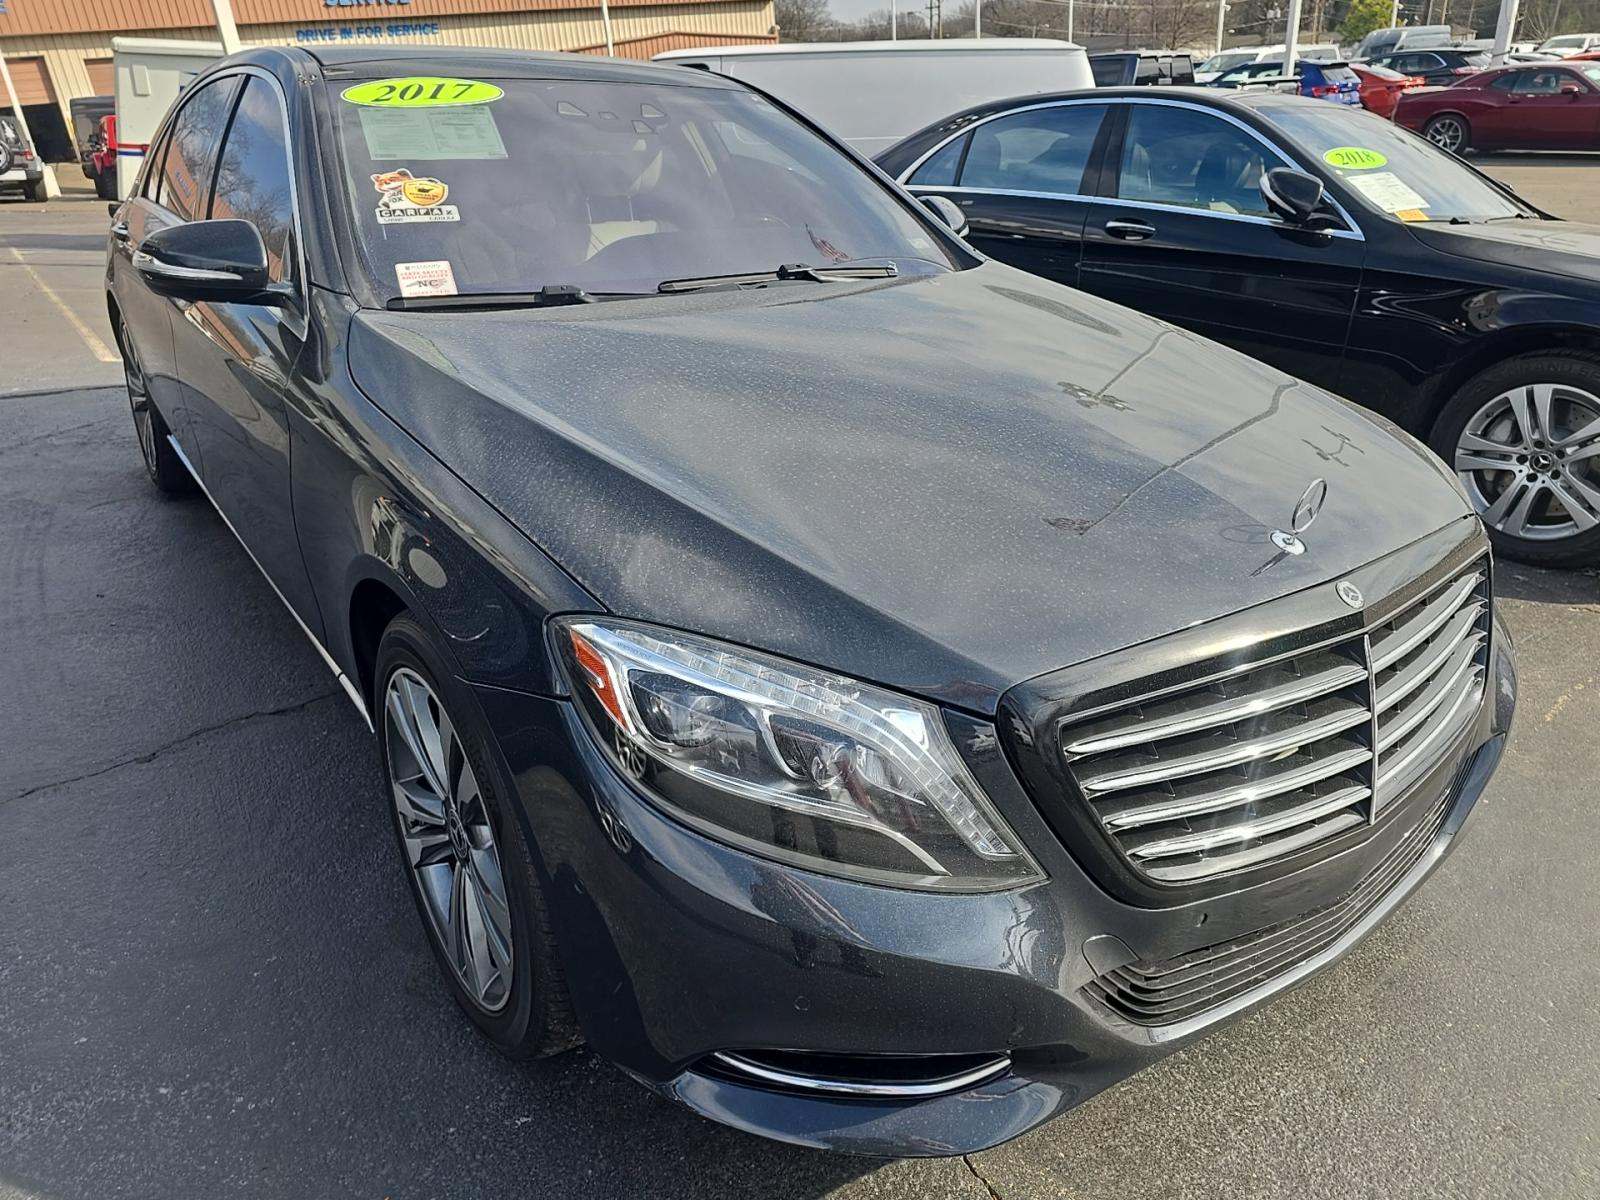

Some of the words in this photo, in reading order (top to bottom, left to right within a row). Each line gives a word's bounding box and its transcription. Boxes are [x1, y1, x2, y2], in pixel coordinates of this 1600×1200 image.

[296, 29, 336, 42] DRIVE
[339, 26, 353, 39] IN
[356, 25, 383, 39] FOR
[387, 23, 439, 36] SERVICE
[371, 83, 474, 102] 2017
[1335, 151, 1376, 165] 2018
[379, 207, 453, 217] CARFAX
[418, 279, 440, 288] NC
